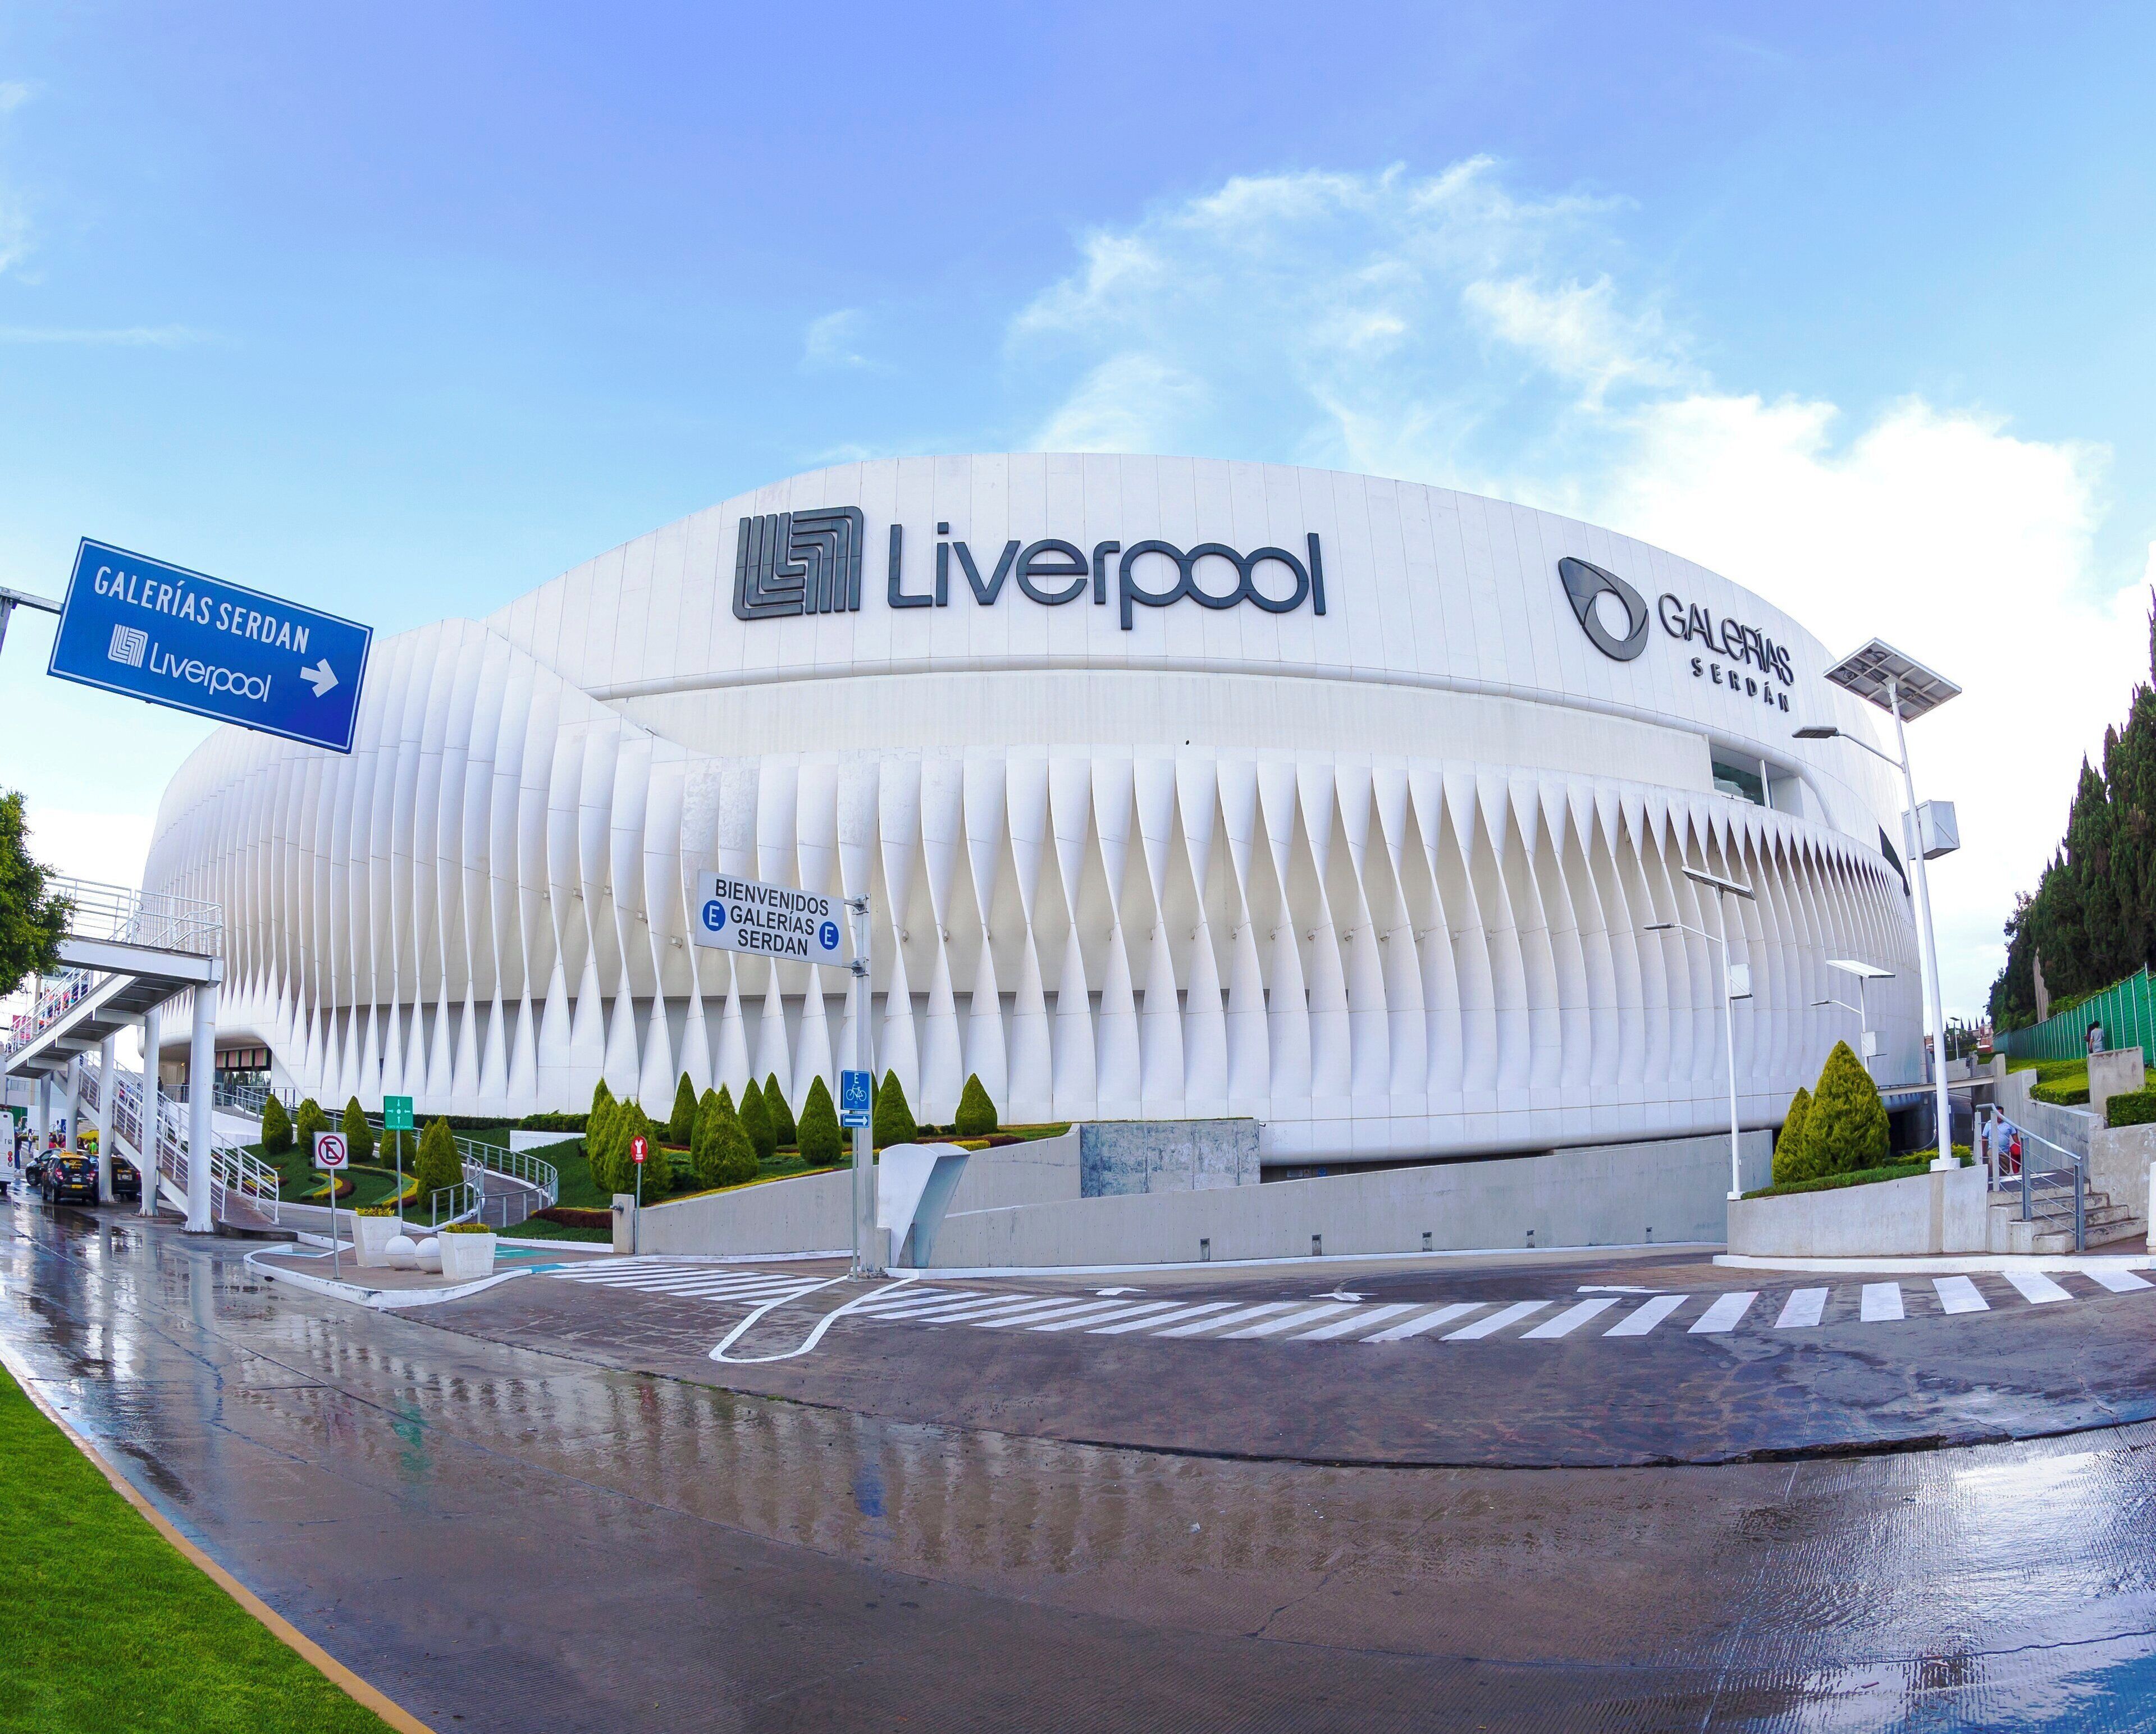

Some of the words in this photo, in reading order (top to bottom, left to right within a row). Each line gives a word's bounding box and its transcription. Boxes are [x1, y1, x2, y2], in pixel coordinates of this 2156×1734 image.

[888, 521, 1327, 631] Liverpool
[94, 566, 213, 625] GALERÍAS
[216, 603, 310, 654] SERDAN
[149, 642, 272, 703] Liverpool
[1691, 657, 1790, 713] SERDÁN
[715, 879, 829, 917] BIENVENIDOS
[709, 905, 720, 927] E
[730, 905, 814, 936] GALERÍAS
[737, 928, 808, 956] SERDAN
[824, 926, 834, 945] E
[854, 1073, 859, 1084] E
